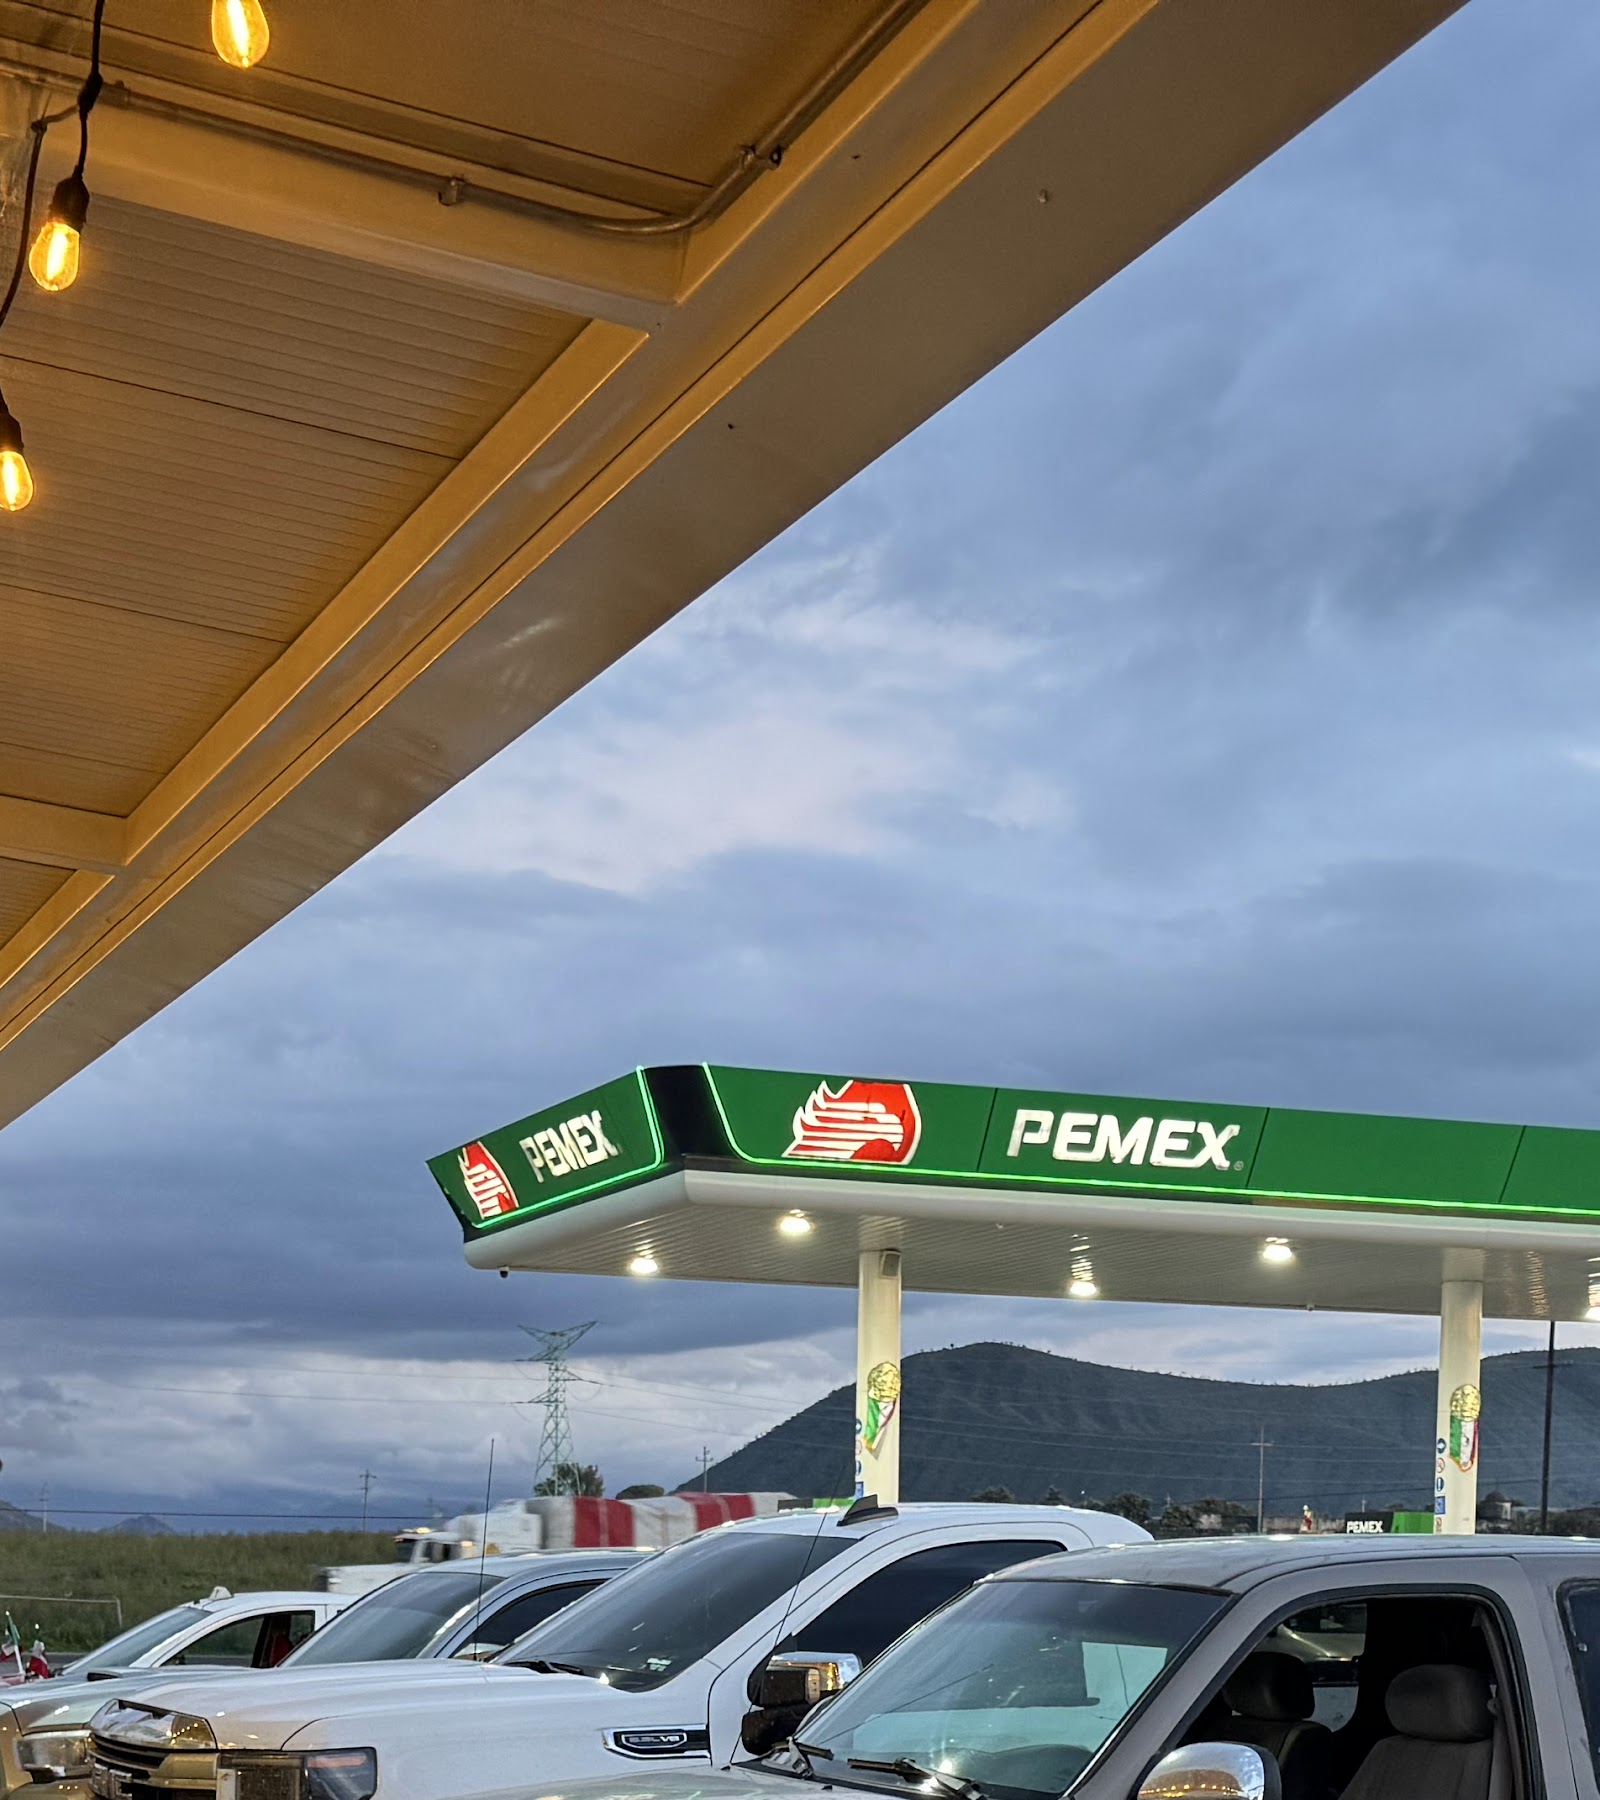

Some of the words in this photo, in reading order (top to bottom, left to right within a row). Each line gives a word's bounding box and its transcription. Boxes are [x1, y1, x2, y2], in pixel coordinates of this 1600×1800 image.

[518, 1109, 619, 1183] PEMEX
[1006, 1108, 1241, 1171] PEMEX
[1346, 1520, 1384, 1534] PEMEX
